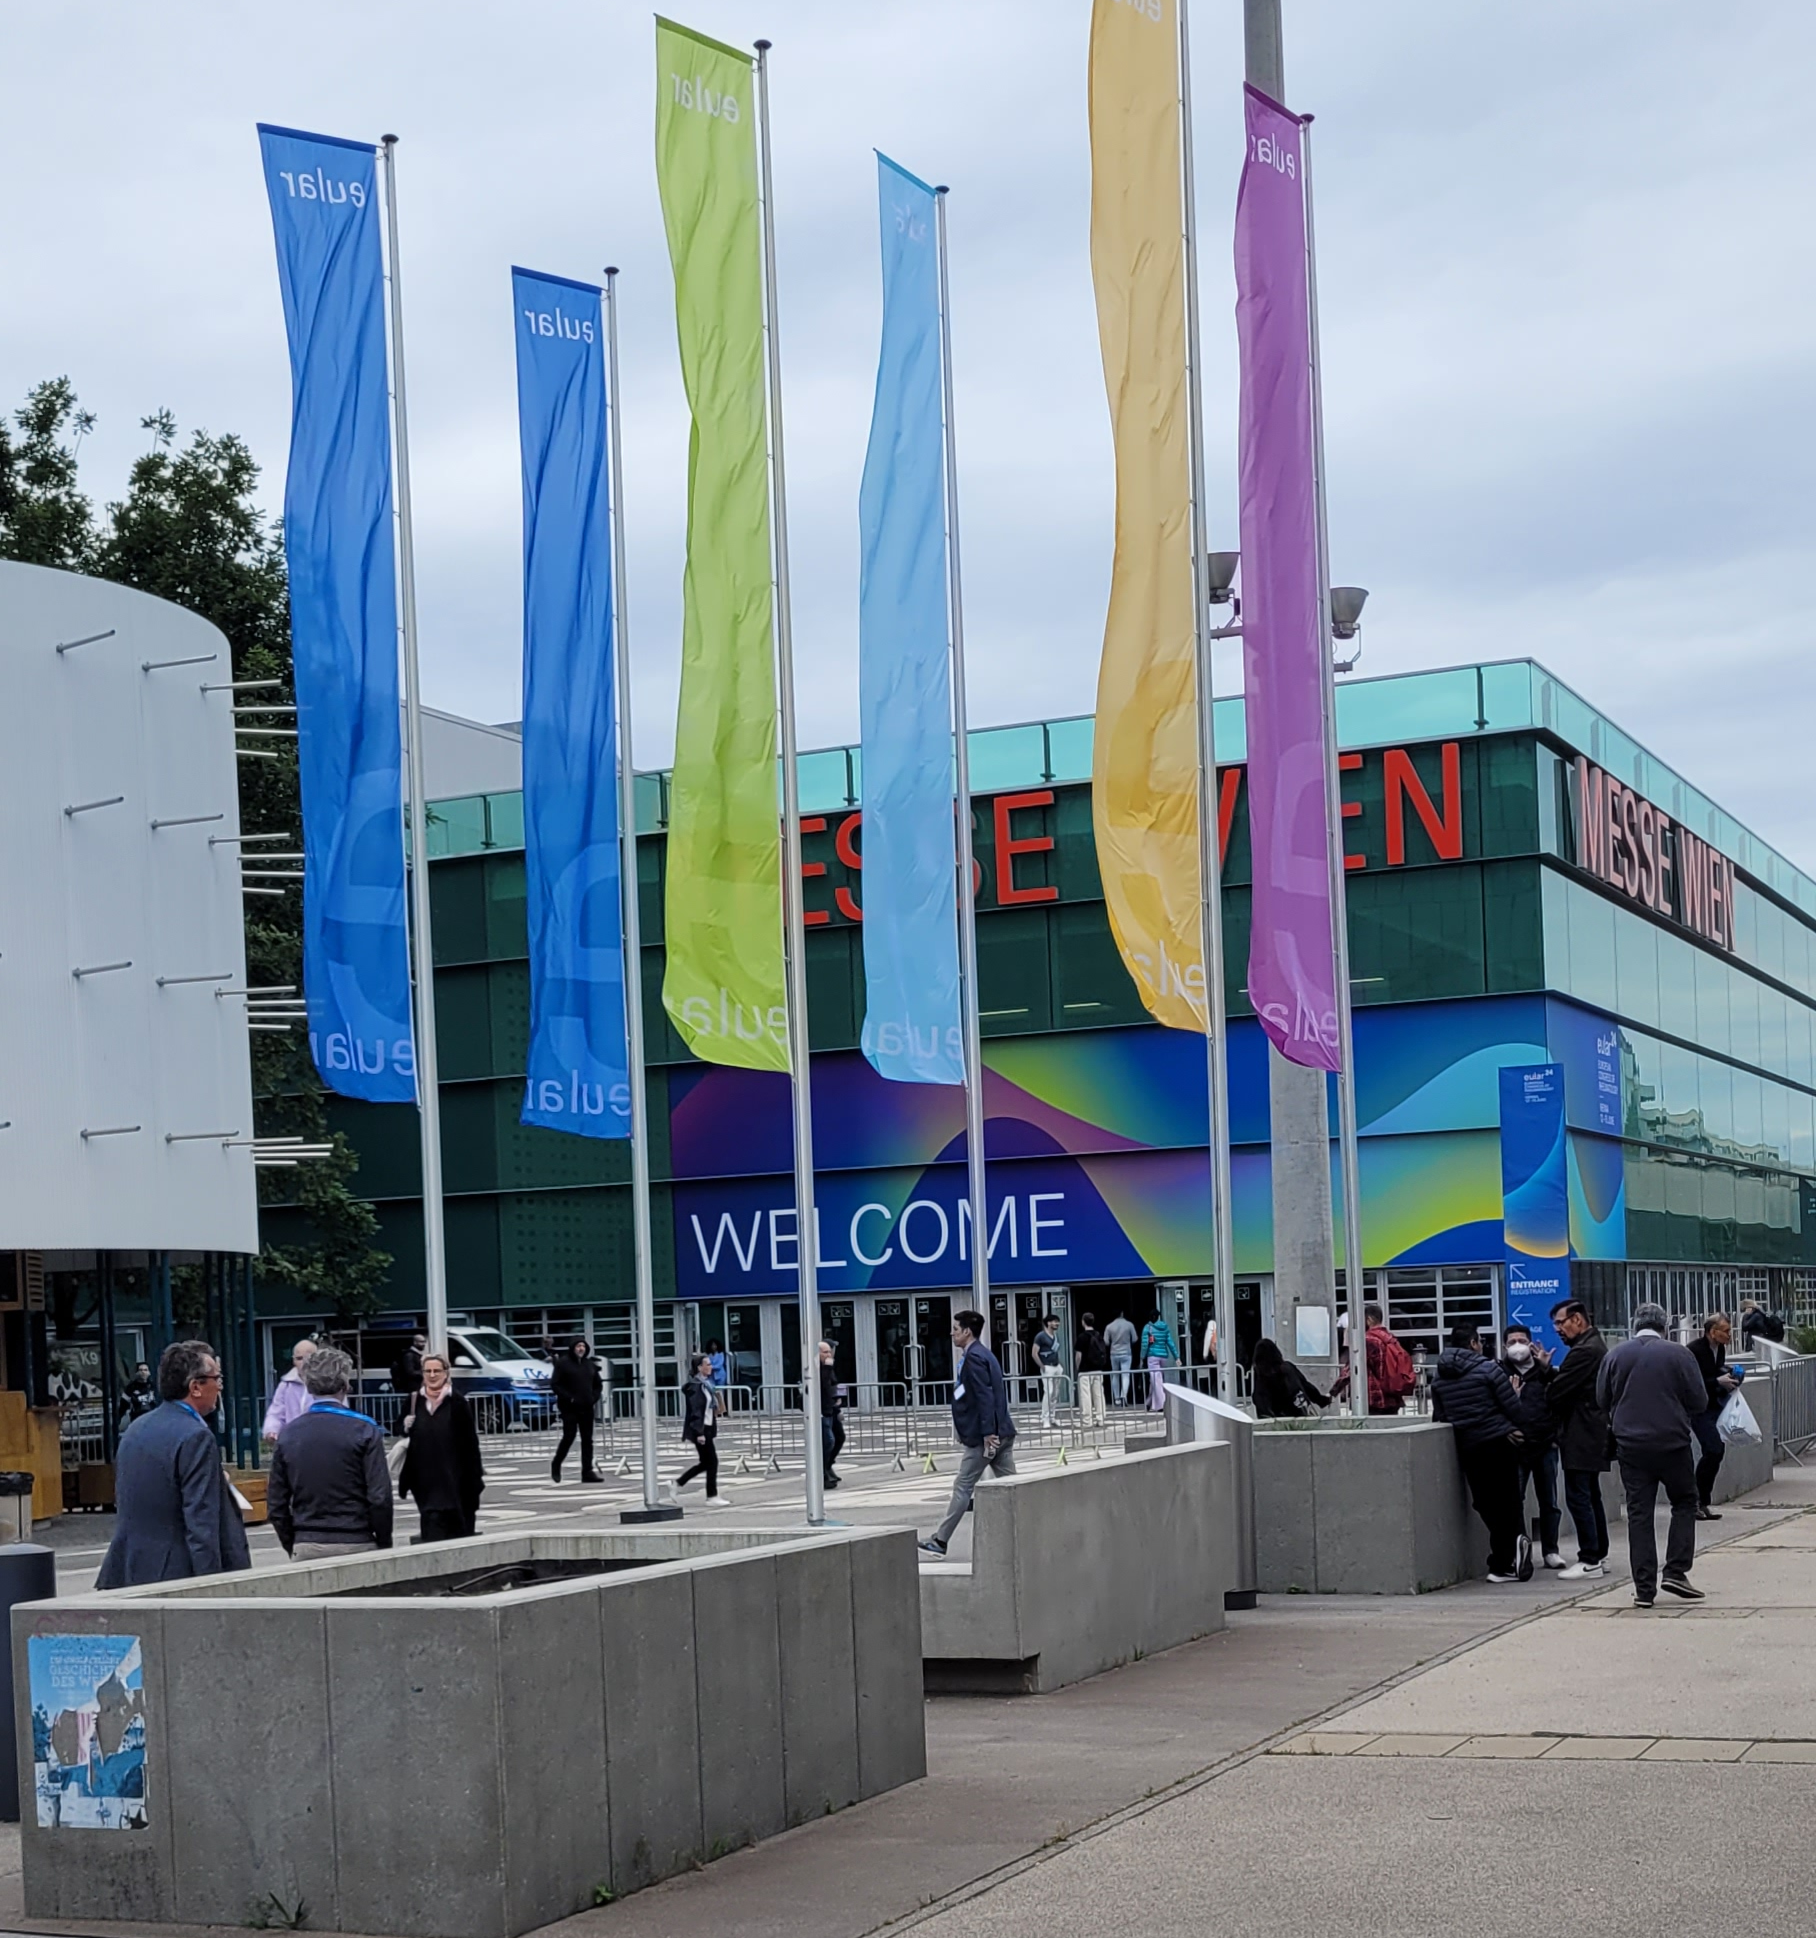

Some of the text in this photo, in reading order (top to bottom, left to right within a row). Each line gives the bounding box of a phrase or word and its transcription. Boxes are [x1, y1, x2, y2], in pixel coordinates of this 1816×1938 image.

[1574, 755, 1737, 952] MESSE WIEN
[690, 1193, 1068, 1274] WELCOME
[1510, 1279, 1559, 1289] ENTRANCE
[1510, 1288, 1557, 1296] REGISTRATION
[80, 1351, 98, 1365] K9
